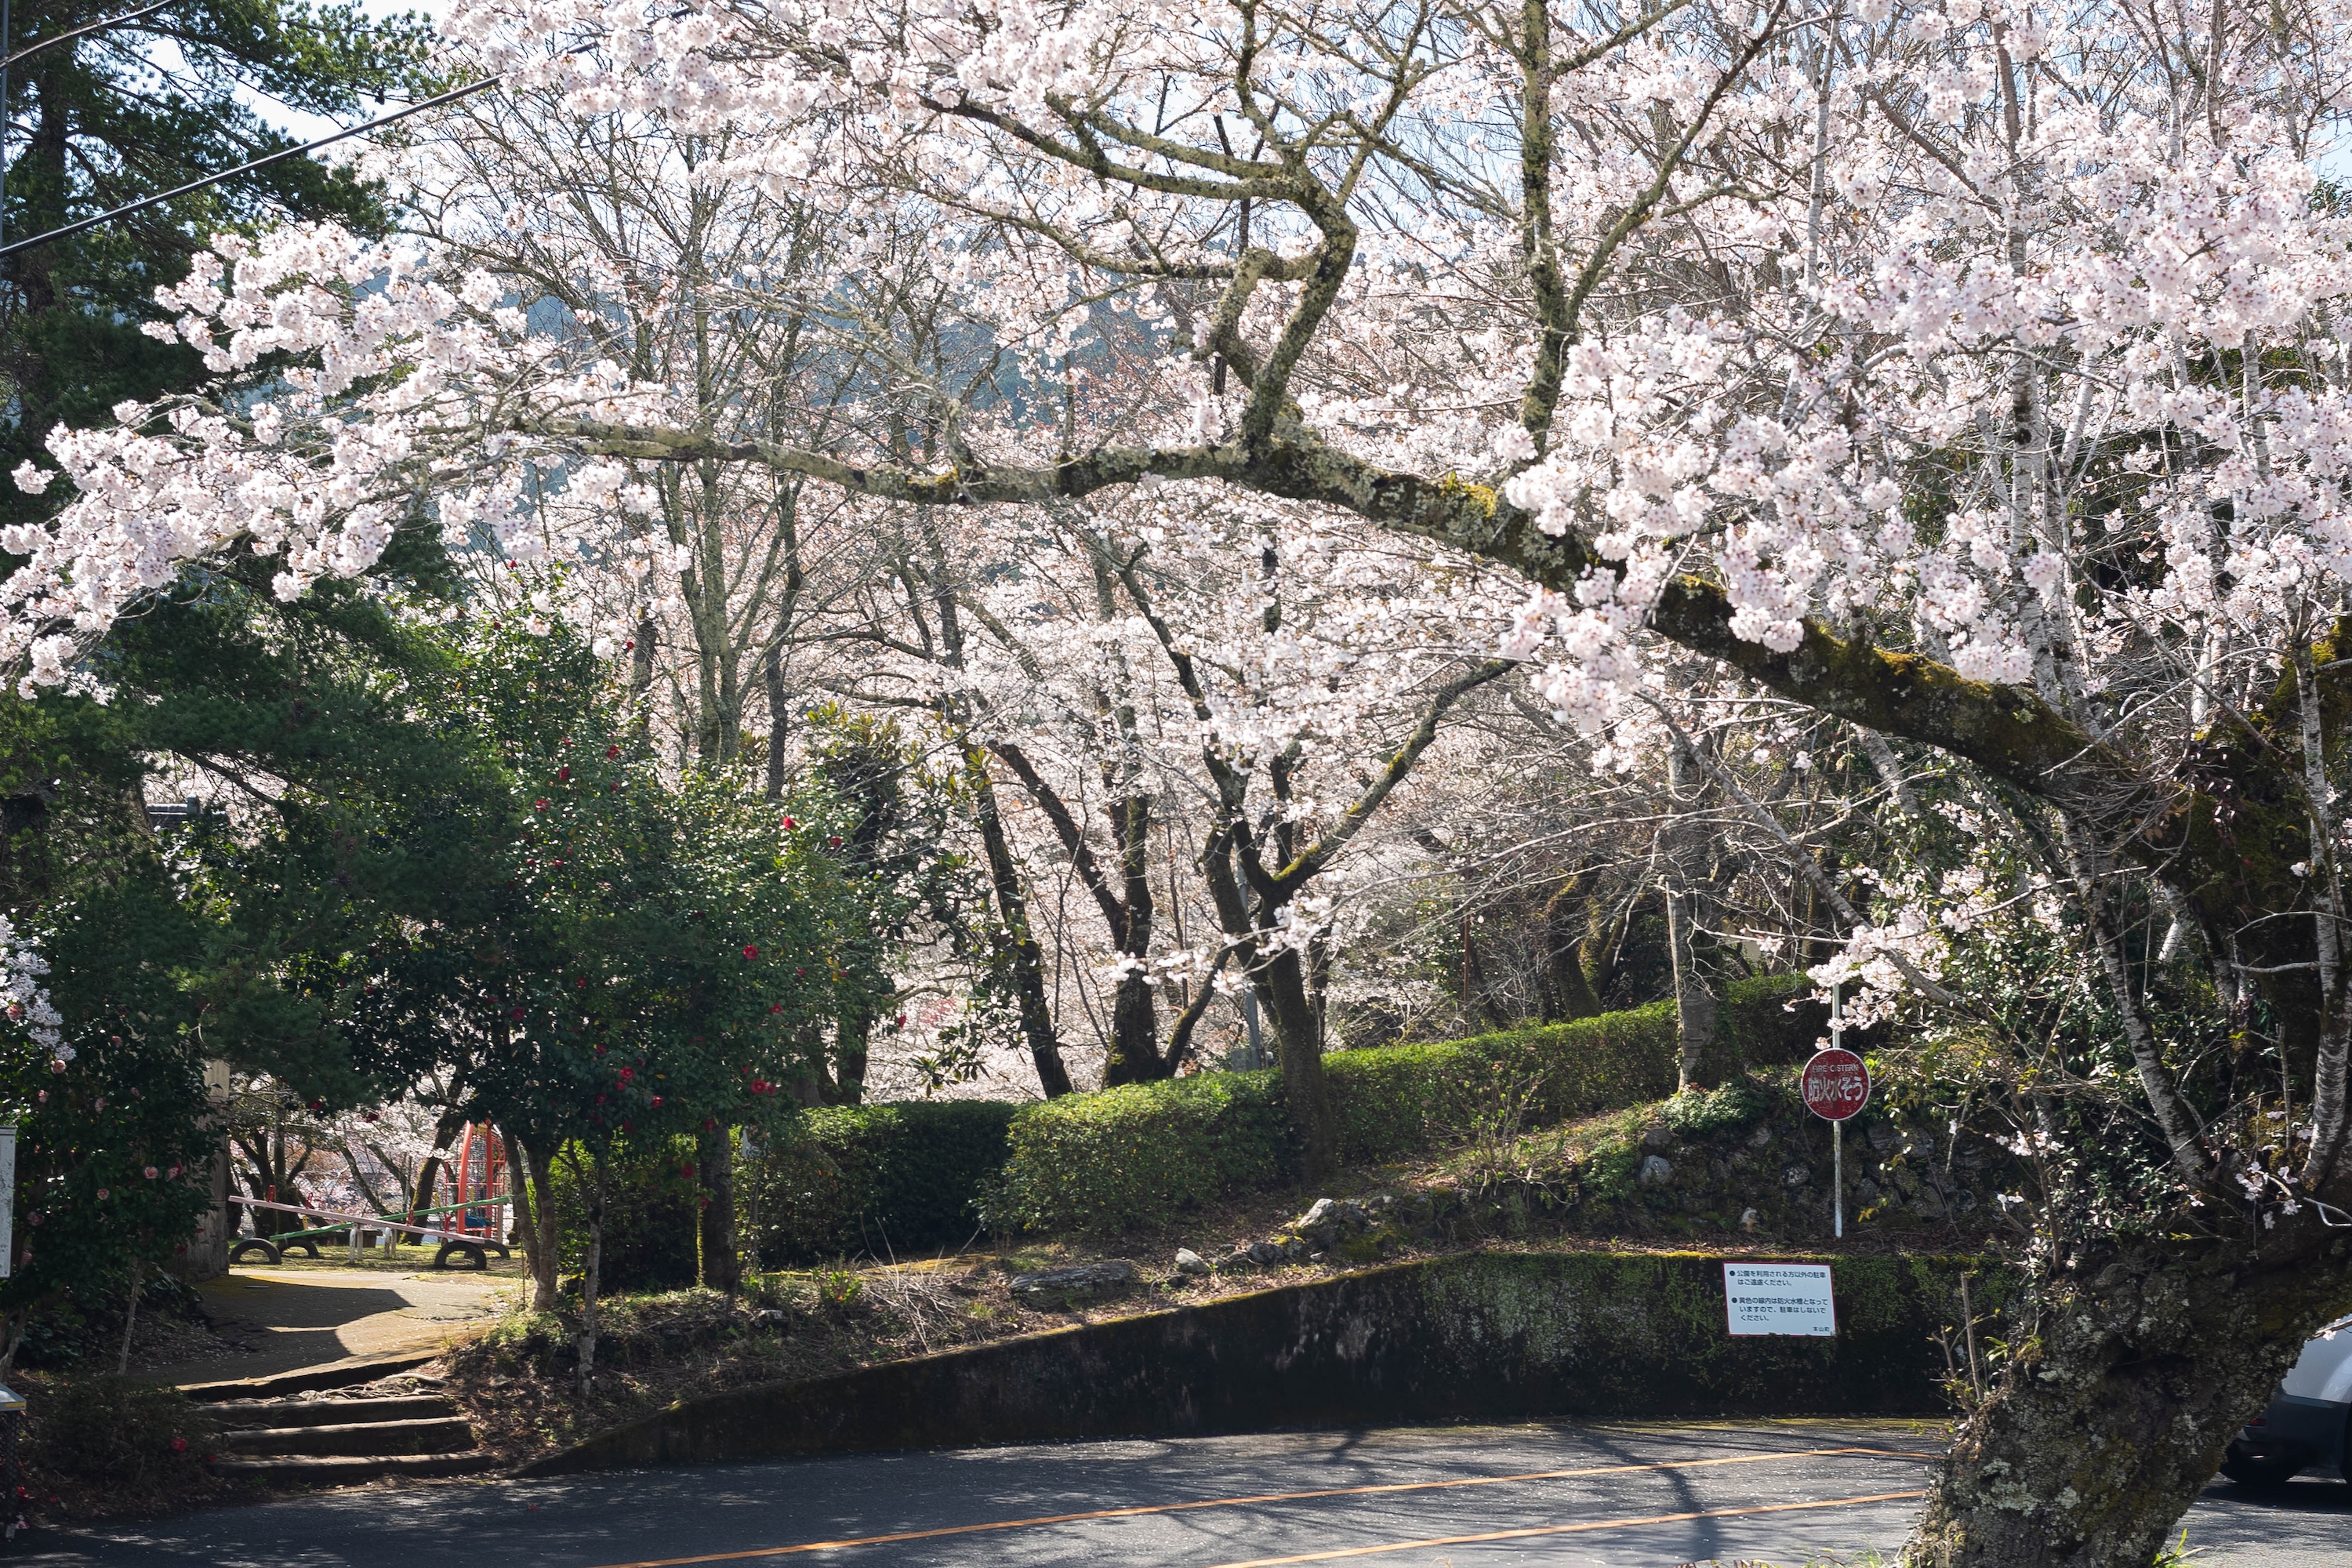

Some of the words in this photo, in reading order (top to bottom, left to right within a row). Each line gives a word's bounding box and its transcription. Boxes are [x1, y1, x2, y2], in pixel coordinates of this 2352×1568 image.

[1830, 1063, 1859, 1073] CSTERN
[1808, 1076, 1863, 1102] 防火水そう
[1739, 1297, 1828, 1305] 黄色の線内は防火水槽となって
